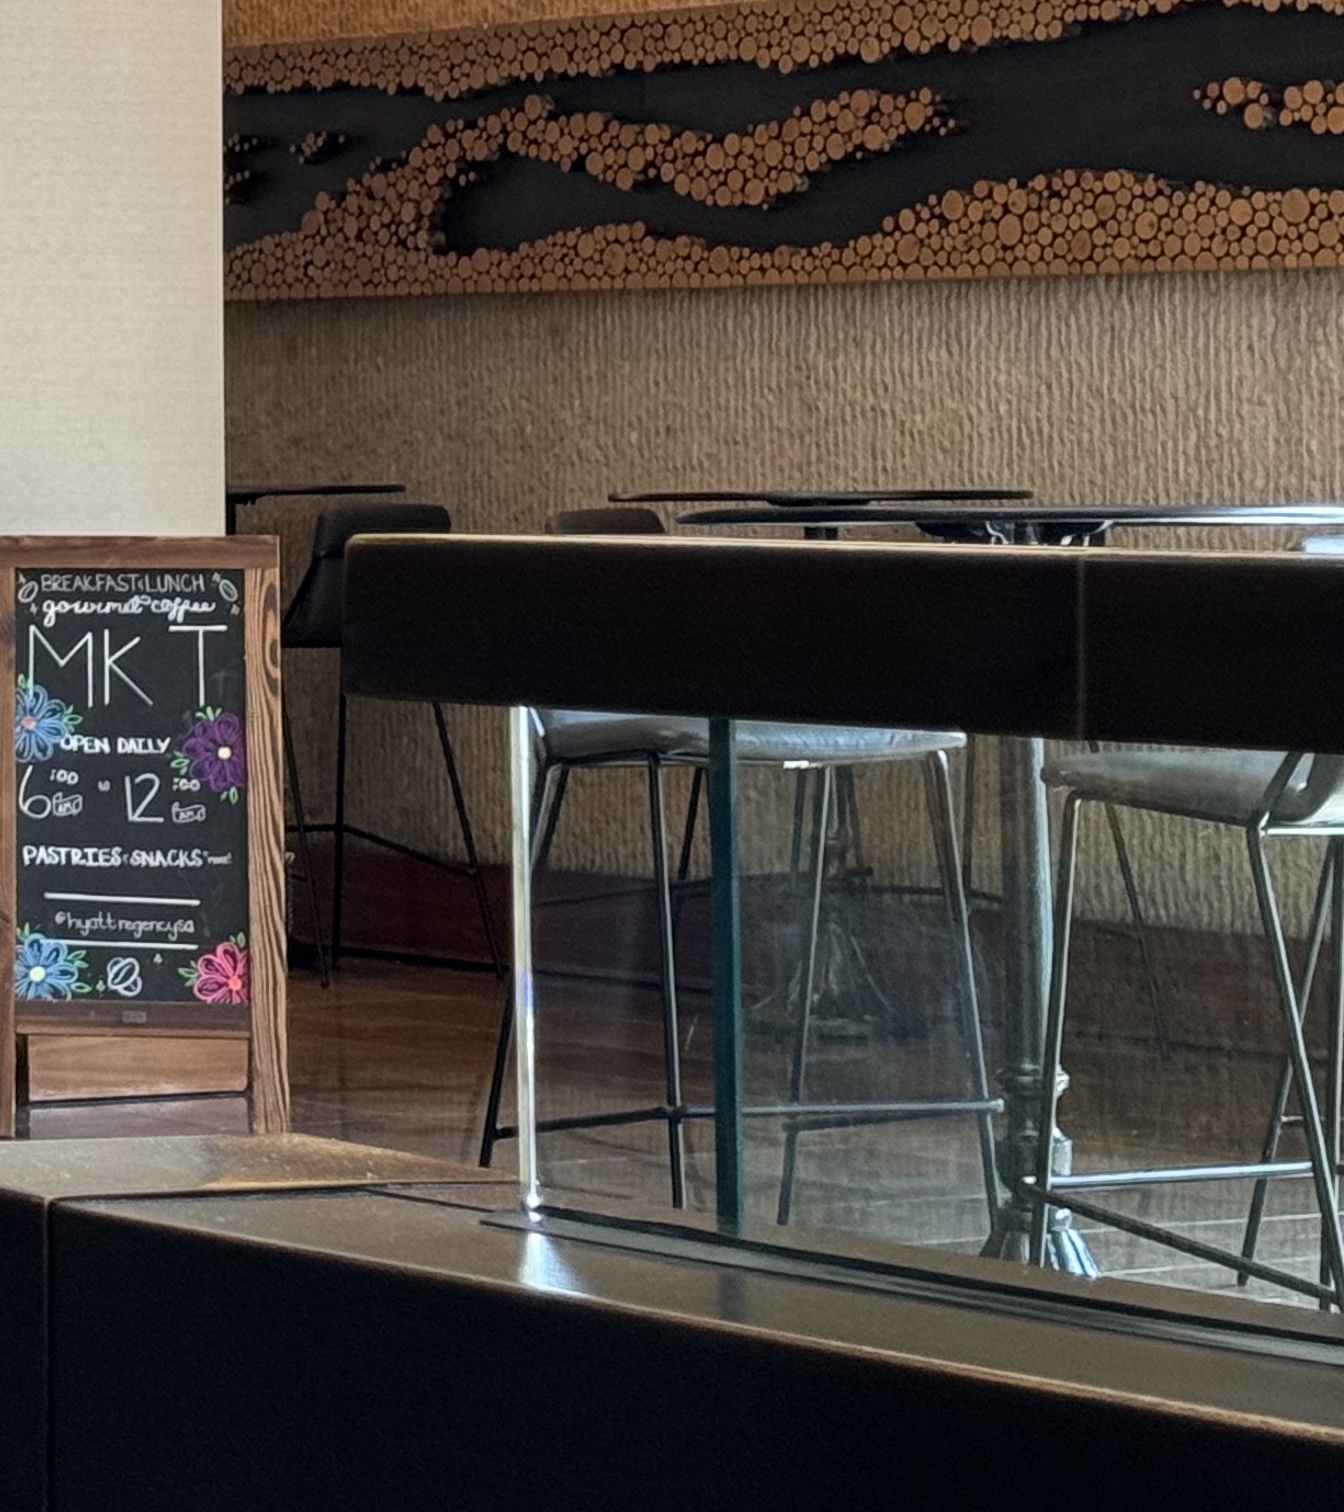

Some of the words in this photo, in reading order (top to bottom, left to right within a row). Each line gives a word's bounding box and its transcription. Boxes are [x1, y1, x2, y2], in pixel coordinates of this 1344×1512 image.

[42, 595, 150, 628] gourmet
[151, 596, 217, 624] coffee
[60, 735, 111, 754] OPEN
[117, 737, 171, 755] DAILY
[22, 844, 123, 867] PASTRIES
[130, 848, 204, 868] SNACKS
